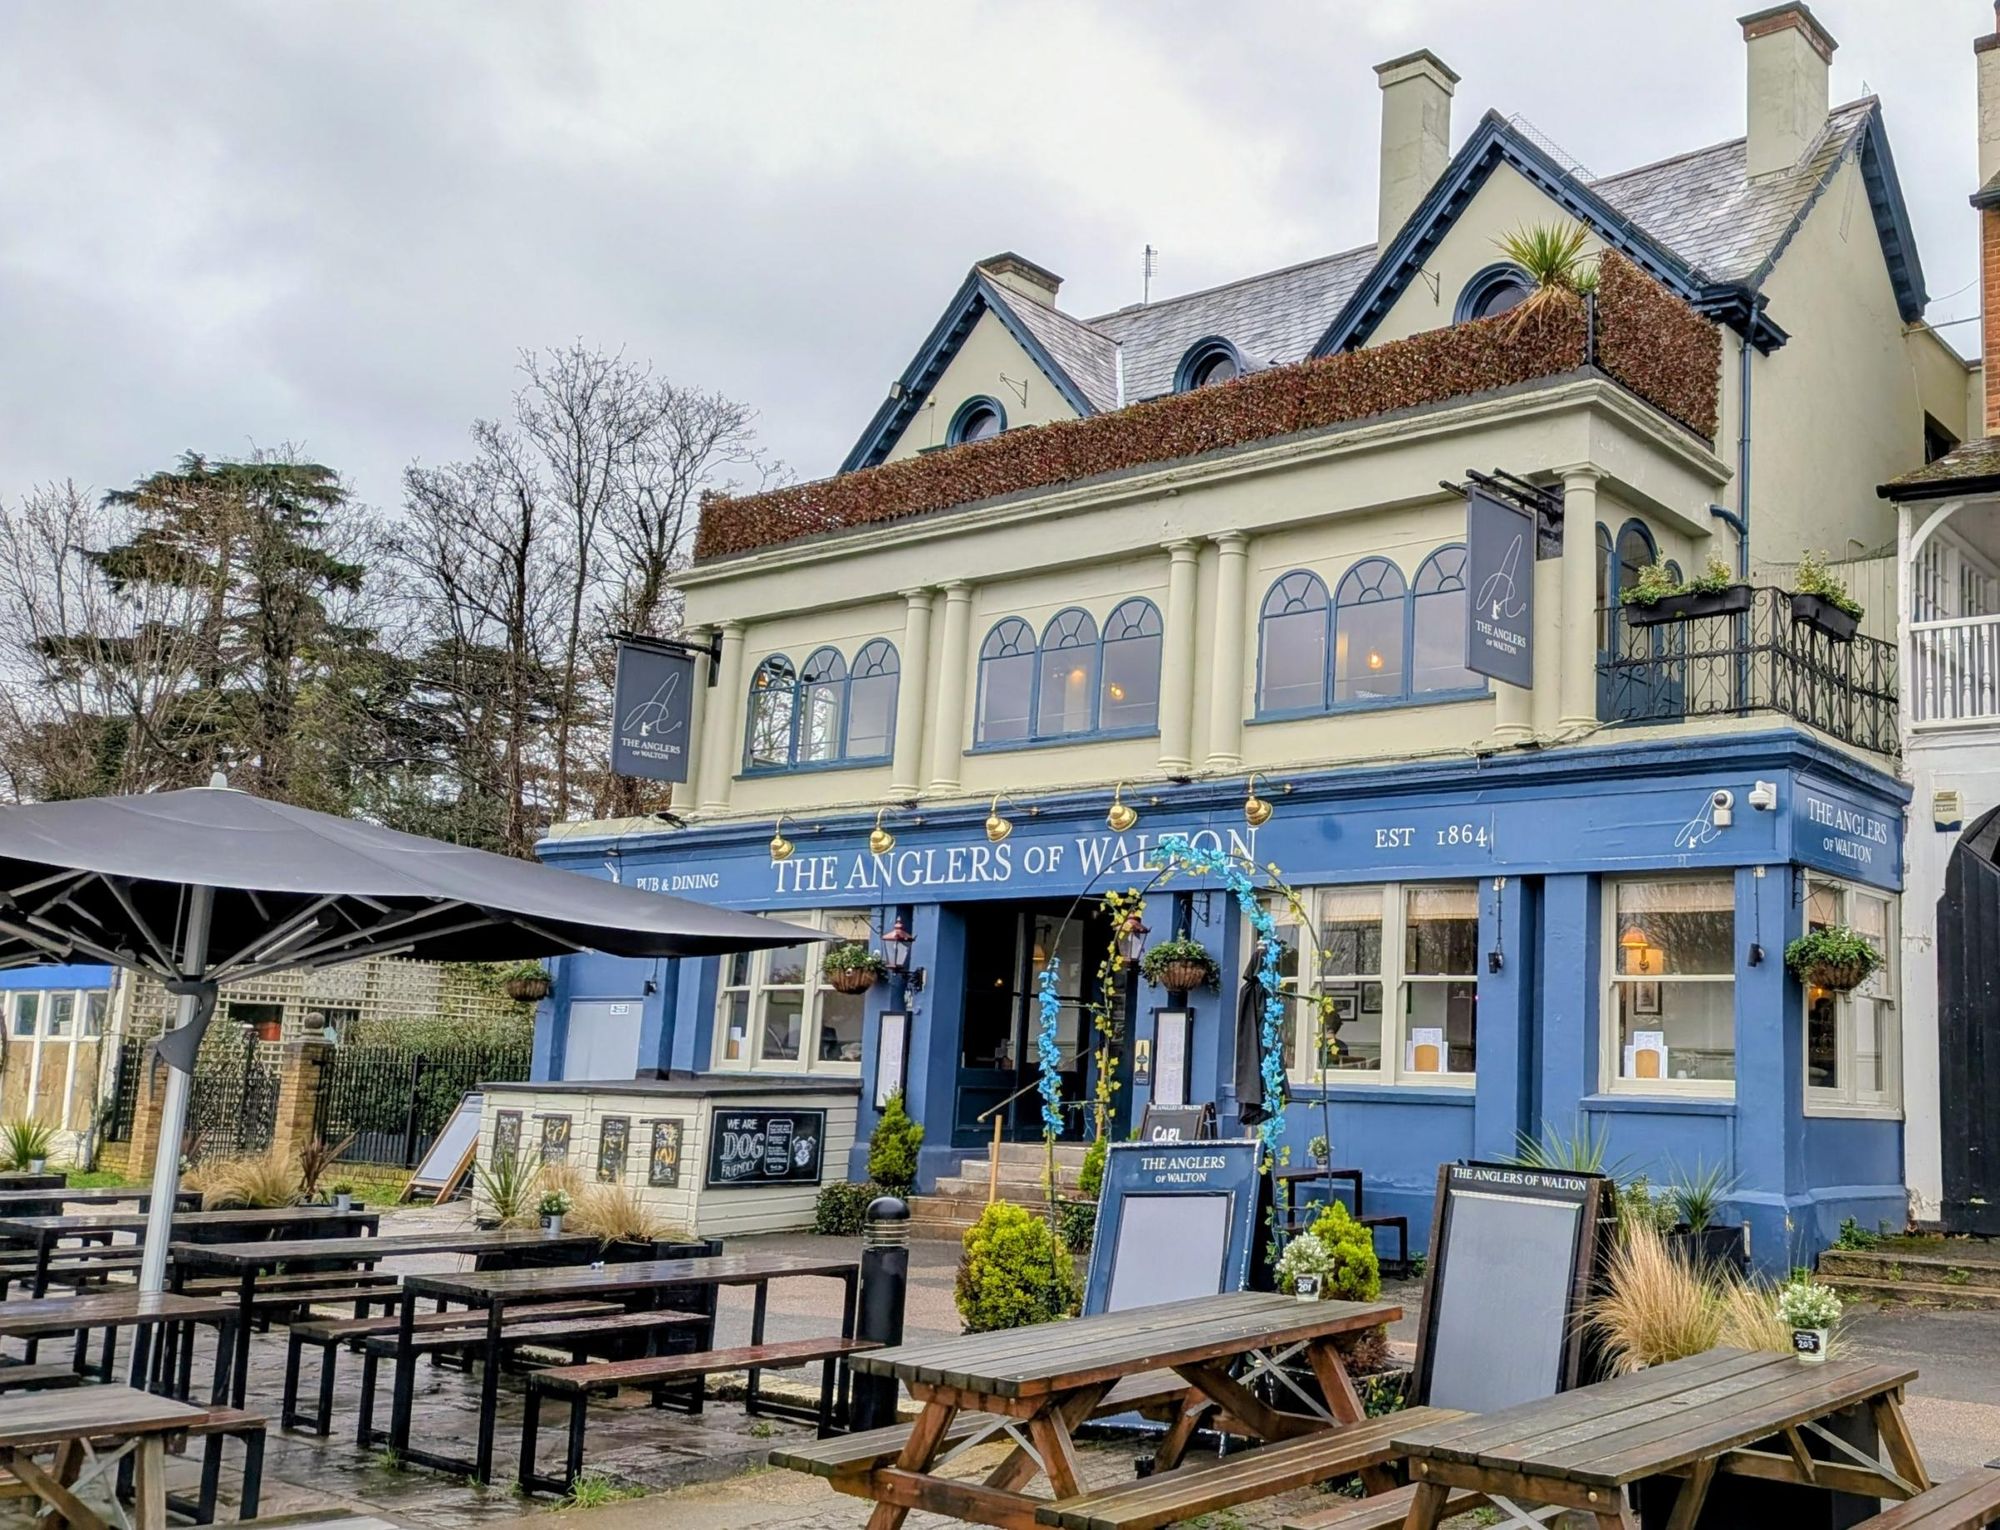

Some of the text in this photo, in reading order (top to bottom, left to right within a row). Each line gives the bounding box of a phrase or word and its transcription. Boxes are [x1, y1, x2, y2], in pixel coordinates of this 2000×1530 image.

[1476, 620, 1526, 648] THE ANGLERS
[1493, 640, 1517, 655] WALTON
[621, 738, 680, 754] THE ANGLERS
[641, 751, 668, 760] WALTON
[1808, 798, 1887, 845] THE ANGLERS
[1375, 824, 1487, 848] EST 1864
[1823, 837, 1873, 865] OF WALTON
[771, 857, 838, 892] THE
[844, 843, 1013, 890] ANGLERS
[1023, 845, 1064, 875] OF
[637, 873, 718, 891] PUB & DINING
[727, 1119, 740, 1130] WE
[741, 1119, 758, 1130] ARE
[720, 1132, 765, 1160] DOG
[721, 1160, 758, 1178] FRIENDLY
[1141, 1156, 1225, 1170] THE ANGLERS
[1155, 1173, 1206, 1183] OF WALTON
[1453, 1168, 1586, 1191] THE ANGLERS OF WALTON
[1298, 1283, 1311, 1292] 201
